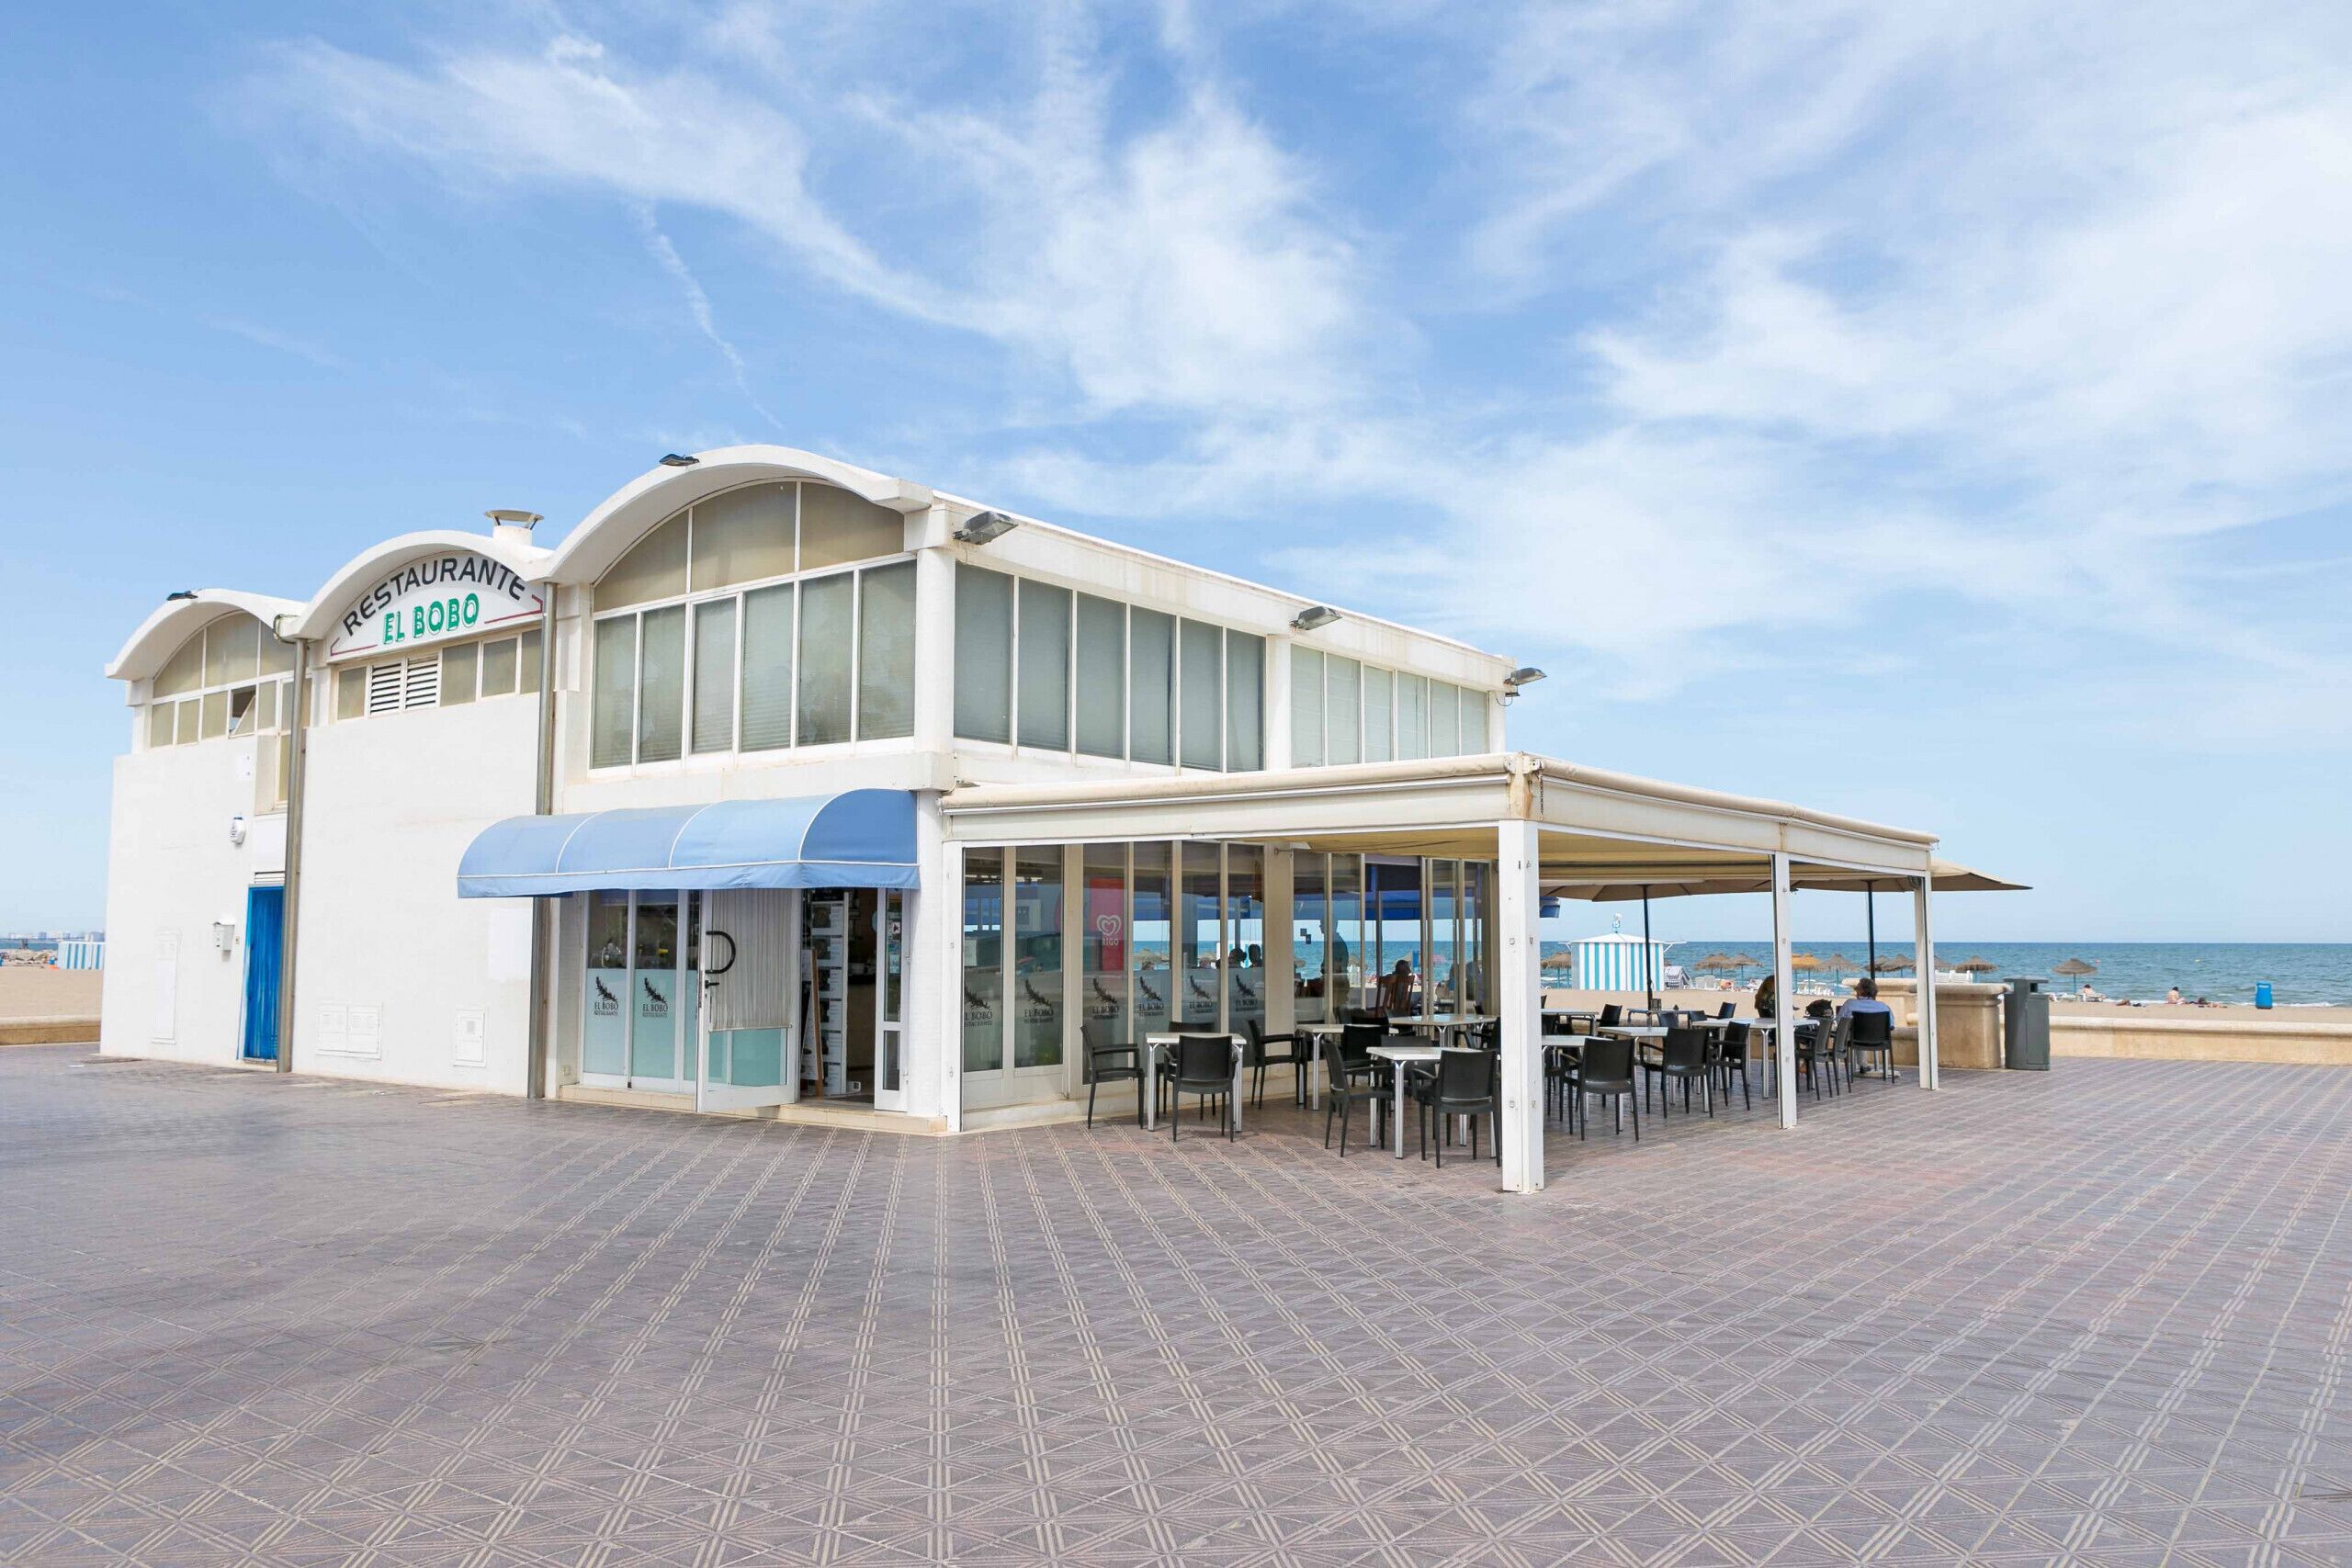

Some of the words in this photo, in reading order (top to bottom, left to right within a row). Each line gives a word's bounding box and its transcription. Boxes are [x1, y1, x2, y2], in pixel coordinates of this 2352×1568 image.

[343, 557, 526, 636] RESTAURANTE
[383, 611, 405, 644] EL
[413, 592, 480, 638] BOBO
[594, 1001, 601, 1010] EL
[602, 1001, 618, 1010] BOBO
[642, 1003, 650, 1012] EL
[650, 1002, 668, 1012] BOBO
